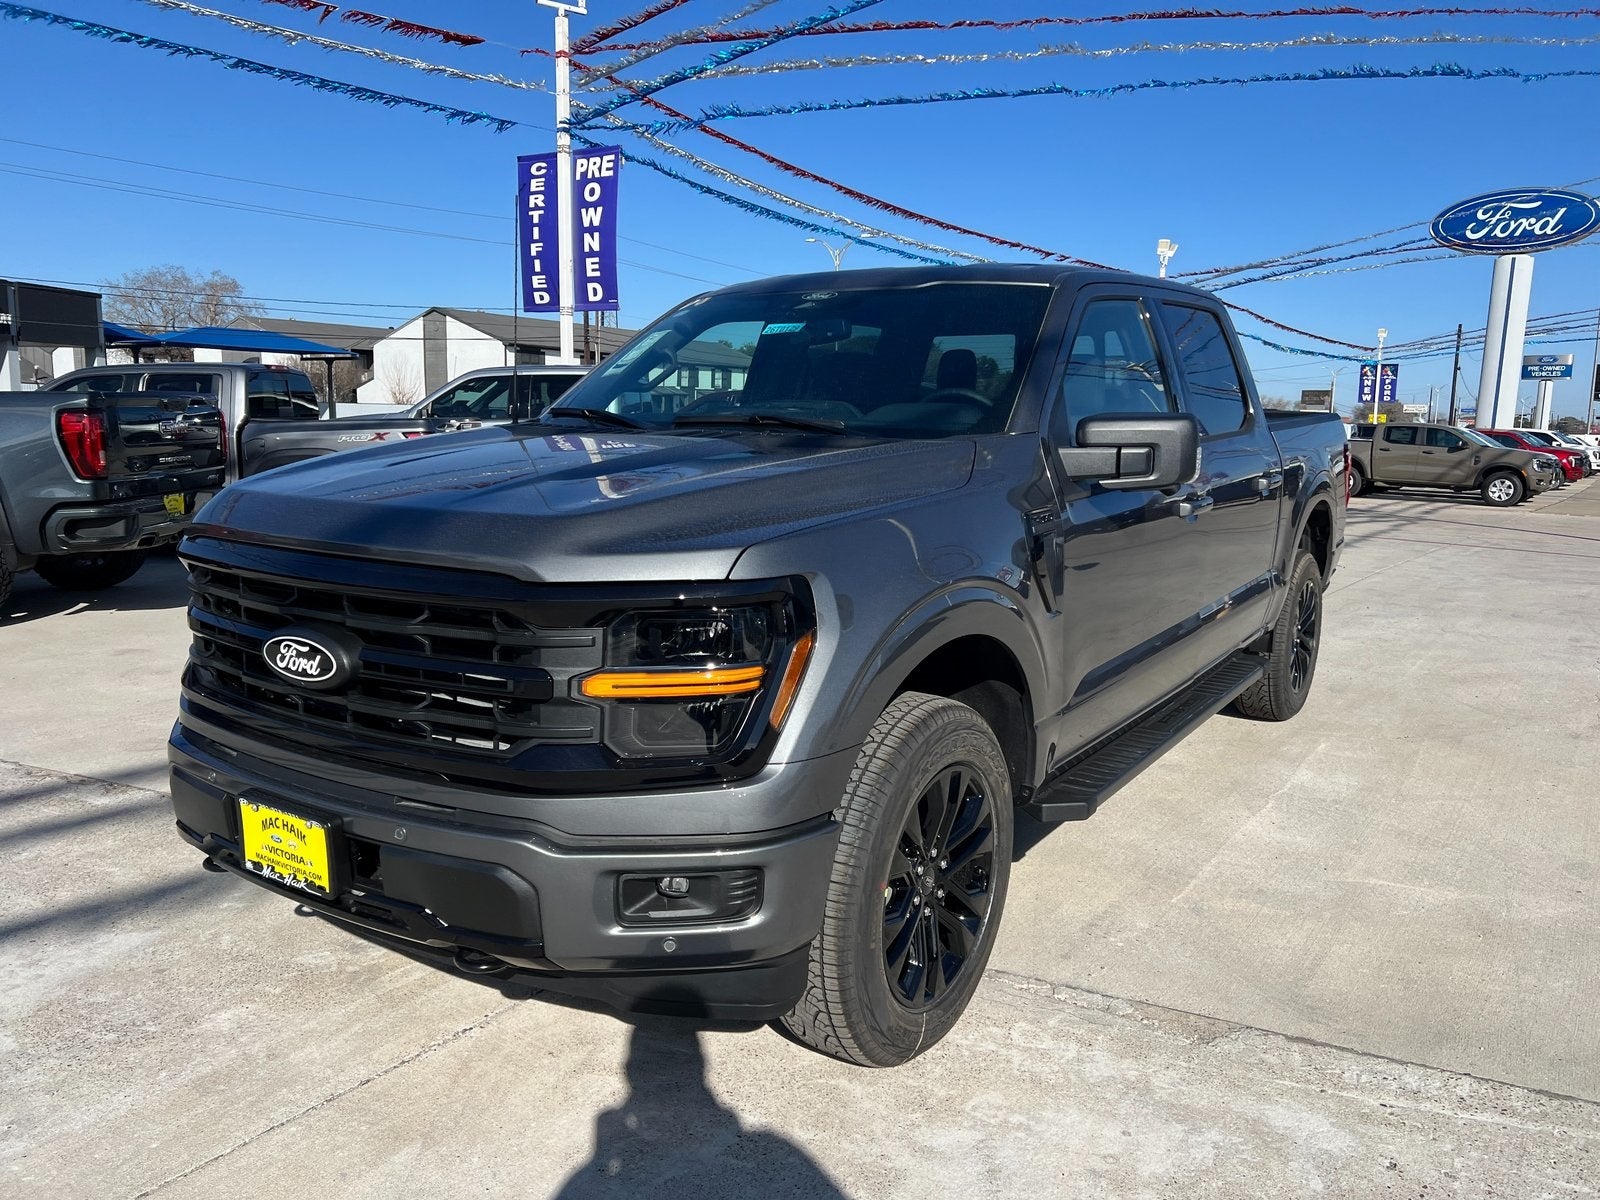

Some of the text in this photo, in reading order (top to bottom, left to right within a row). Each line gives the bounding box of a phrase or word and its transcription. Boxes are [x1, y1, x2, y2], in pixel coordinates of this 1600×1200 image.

[575, 154, 615, 180] PRE
[528, 162, 550, 305] CERTIFIED
[1465, 200, 1567, 240] Ford
[580, 182, 604, 302] OWNED
[1527, 365, 1566, 373] PRE-OWNED
[1362, 379, 1372, 401] NEW
[1383, 379, 1392, 401] FORD
[276, 641, 321, 675] Ford
[261, 817, 307, 846] MAC HAIK
[256, 852, 322, 881] MACHAIKVICTORIA.COM
[267, 844, 305, 863] VICTORIA
[260, 865, 309, 890] Mac Haik
